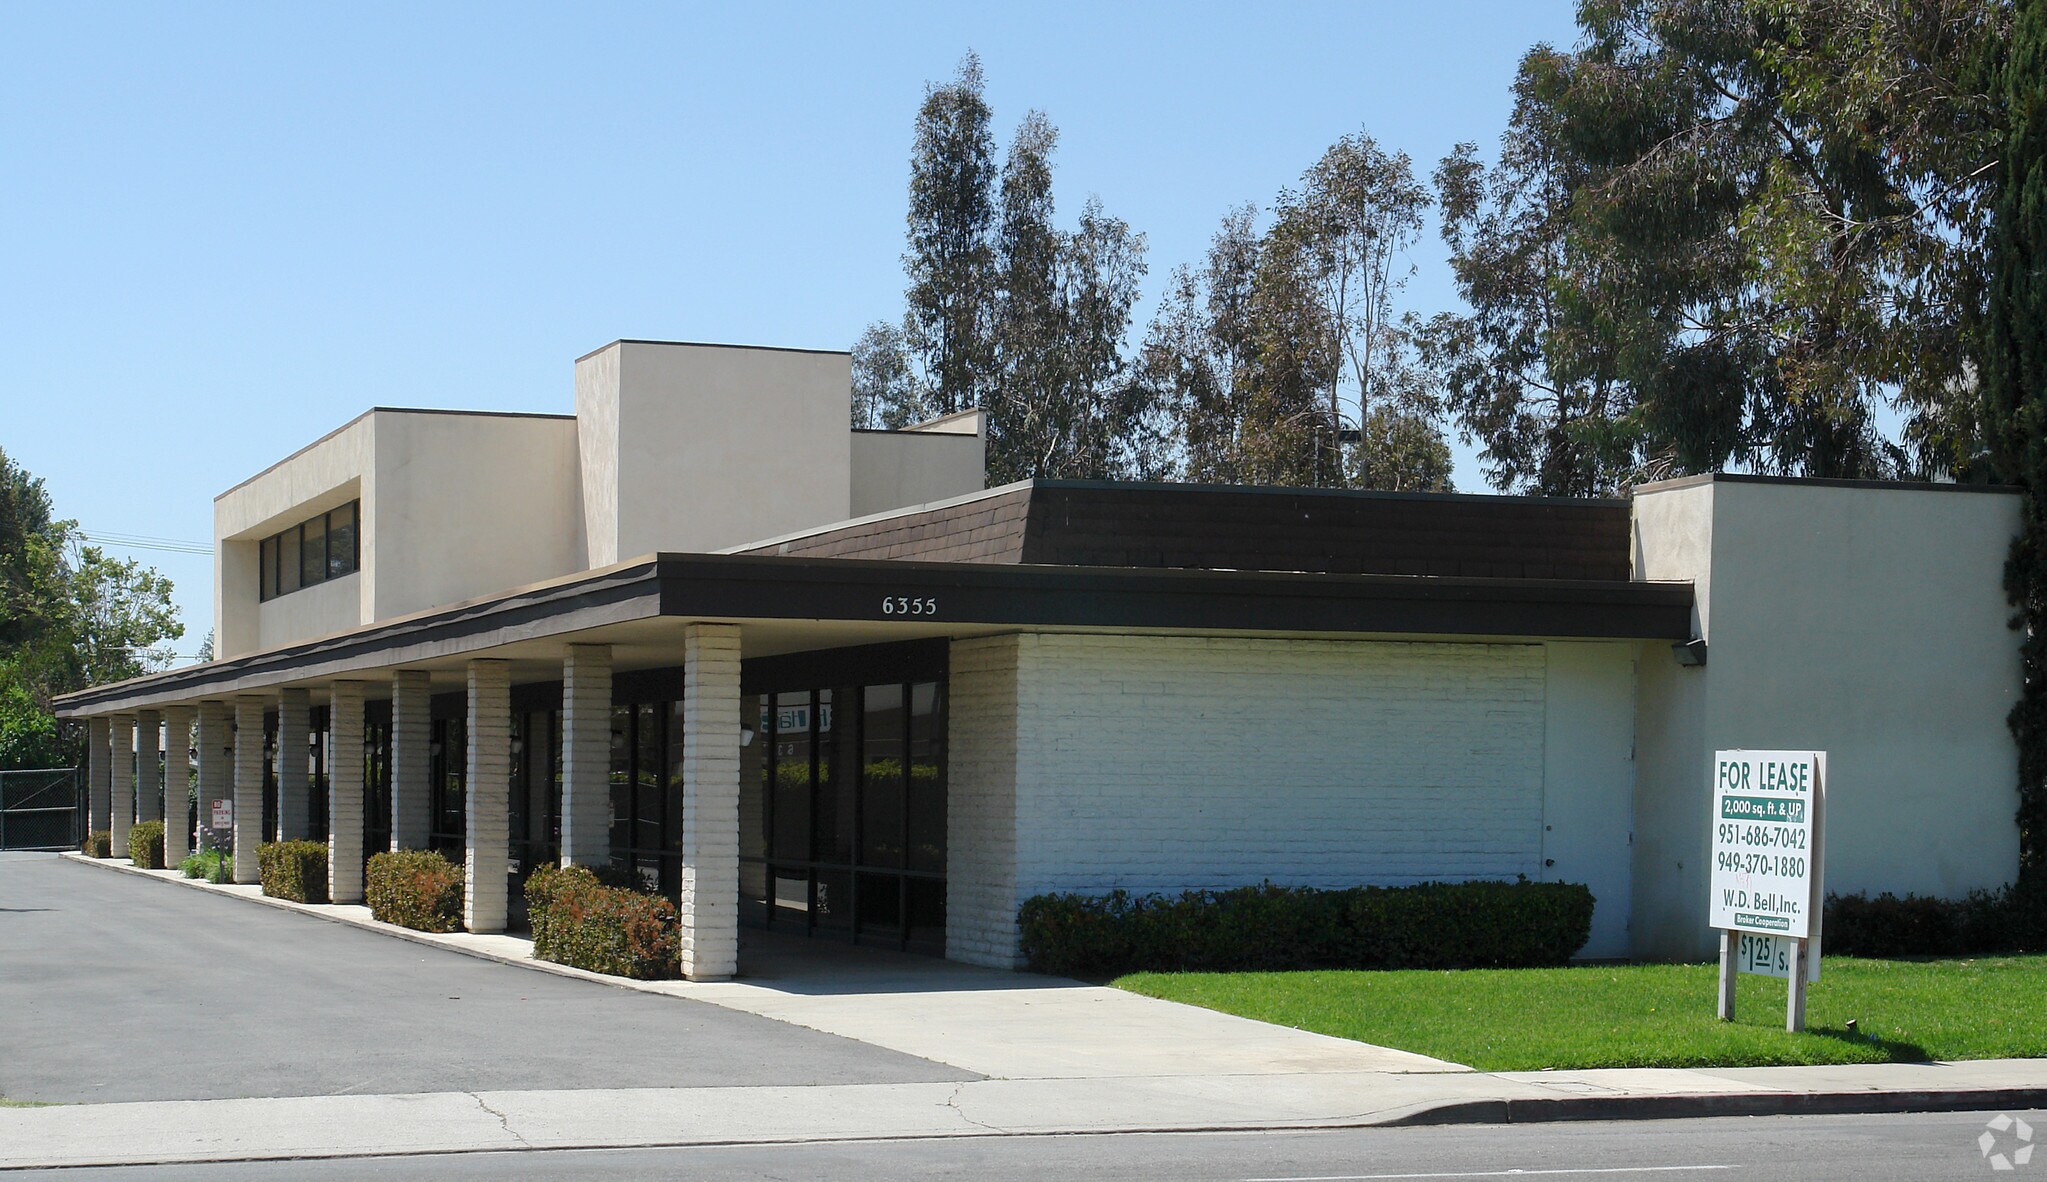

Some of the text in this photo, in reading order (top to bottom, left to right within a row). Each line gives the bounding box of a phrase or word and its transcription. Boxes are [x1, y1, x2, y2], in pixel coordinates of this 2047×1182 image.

[882, 596, 937, 615] 6355
[1719, 761, 1808, 792] FOR LEASE
[1725, 799, 1802, 818] 2,000 sq. ft. & UP
[1719, 823, 1806, 850] 951-686-7042
[1718, 851, 1805, 878] 949-370-1880
[1723, 889, 1750, 909] W.D.
[1736, 914, 1788, 929] Broker Cooperation
